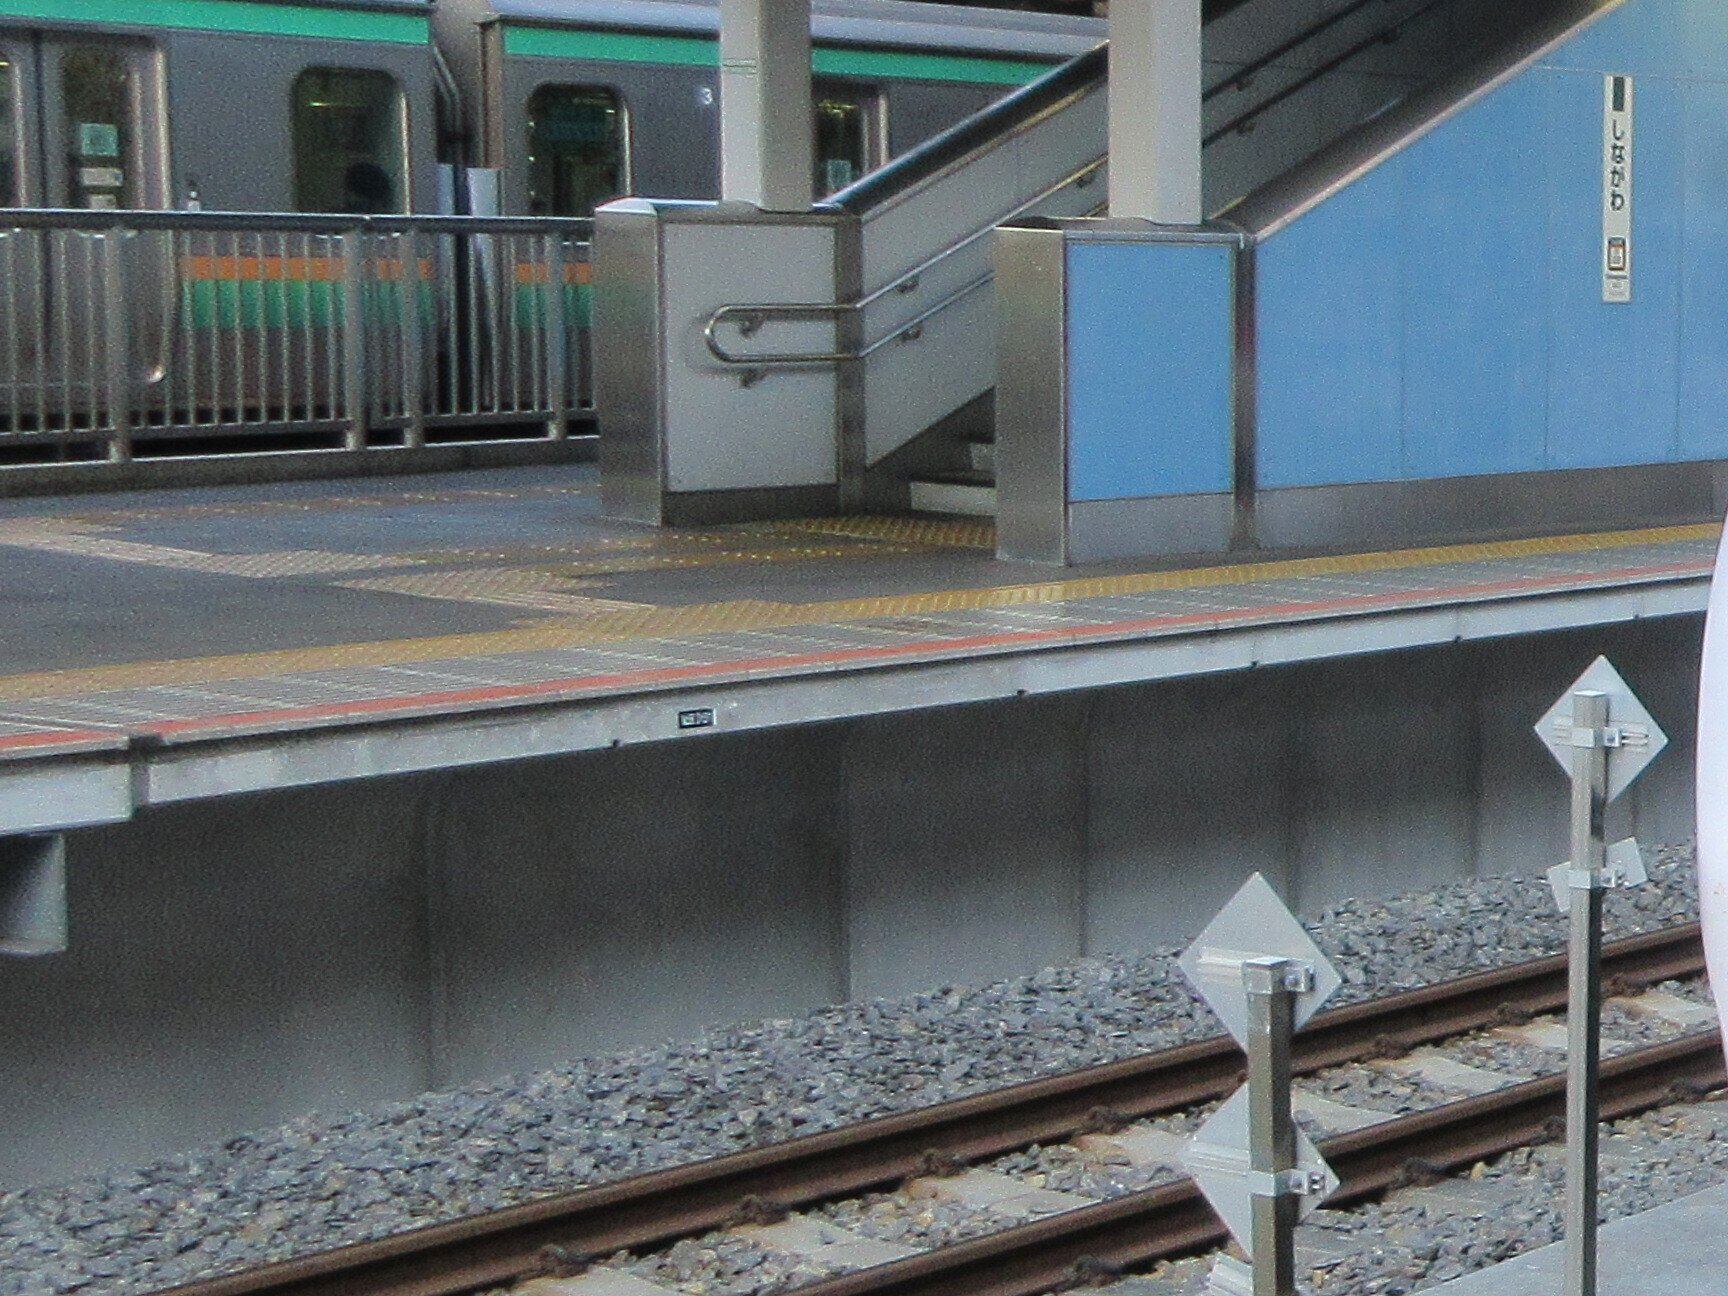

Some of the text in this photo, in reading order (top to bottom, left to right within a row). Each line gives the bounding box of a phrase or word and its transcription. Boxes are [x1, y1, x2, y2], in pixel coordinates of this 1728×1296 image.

[703, 87, 713, 105] 3
[1611, 119, 1625, 211] しながわ
